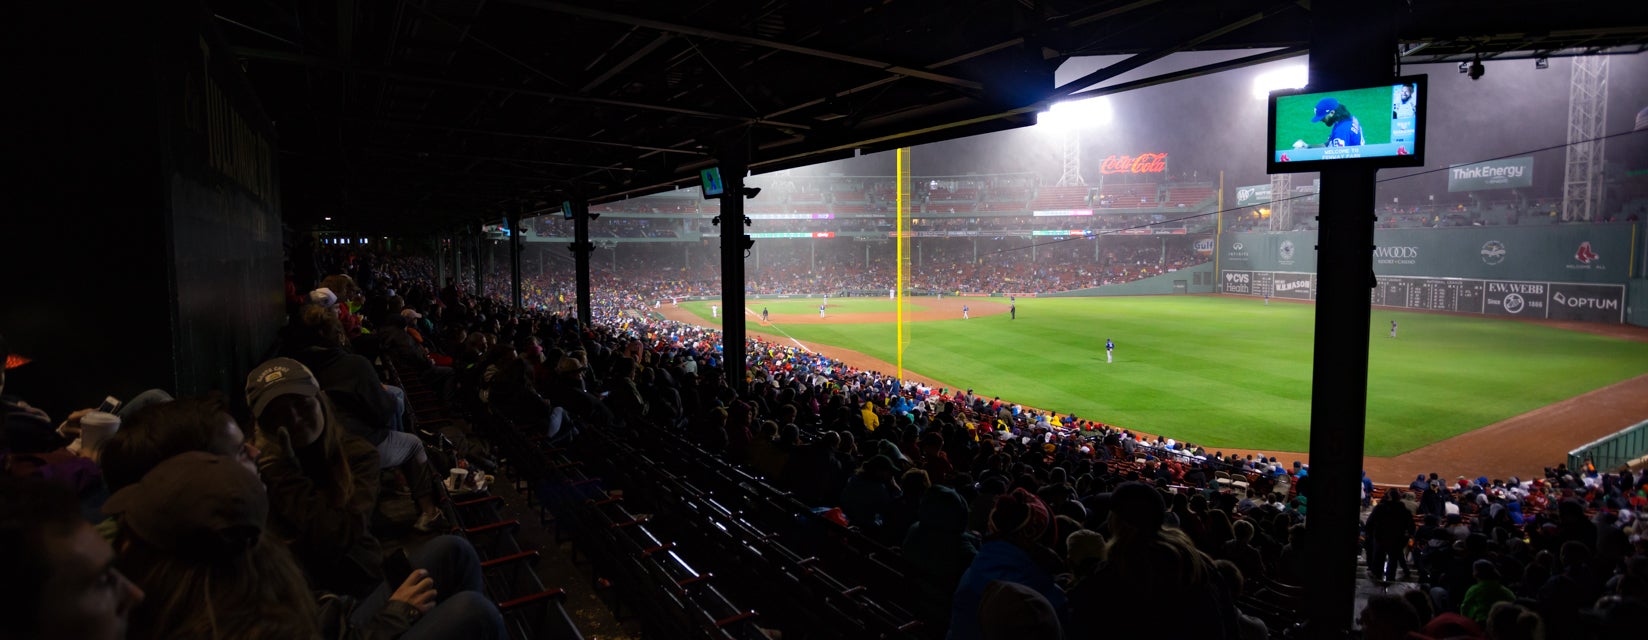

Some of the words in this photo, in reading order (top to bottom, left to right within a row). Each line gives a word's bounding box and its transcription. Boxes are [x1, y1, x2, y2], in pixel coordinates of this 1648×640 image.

[1102, 153, 1168, 174] Coca-Cola
[1453, 166, 1524, 179] ThinkEnergy
[1194, 240, 1213, 249] Gulf
[1233, 273, 1249, 284] CVS
[1226, 282, 1249, 293] Health
[1488, 283, 1508, 293] F.W.
[1509, 284, 1544, 295] WEBB
[1567, 296, 1618, 310] OPTUM
